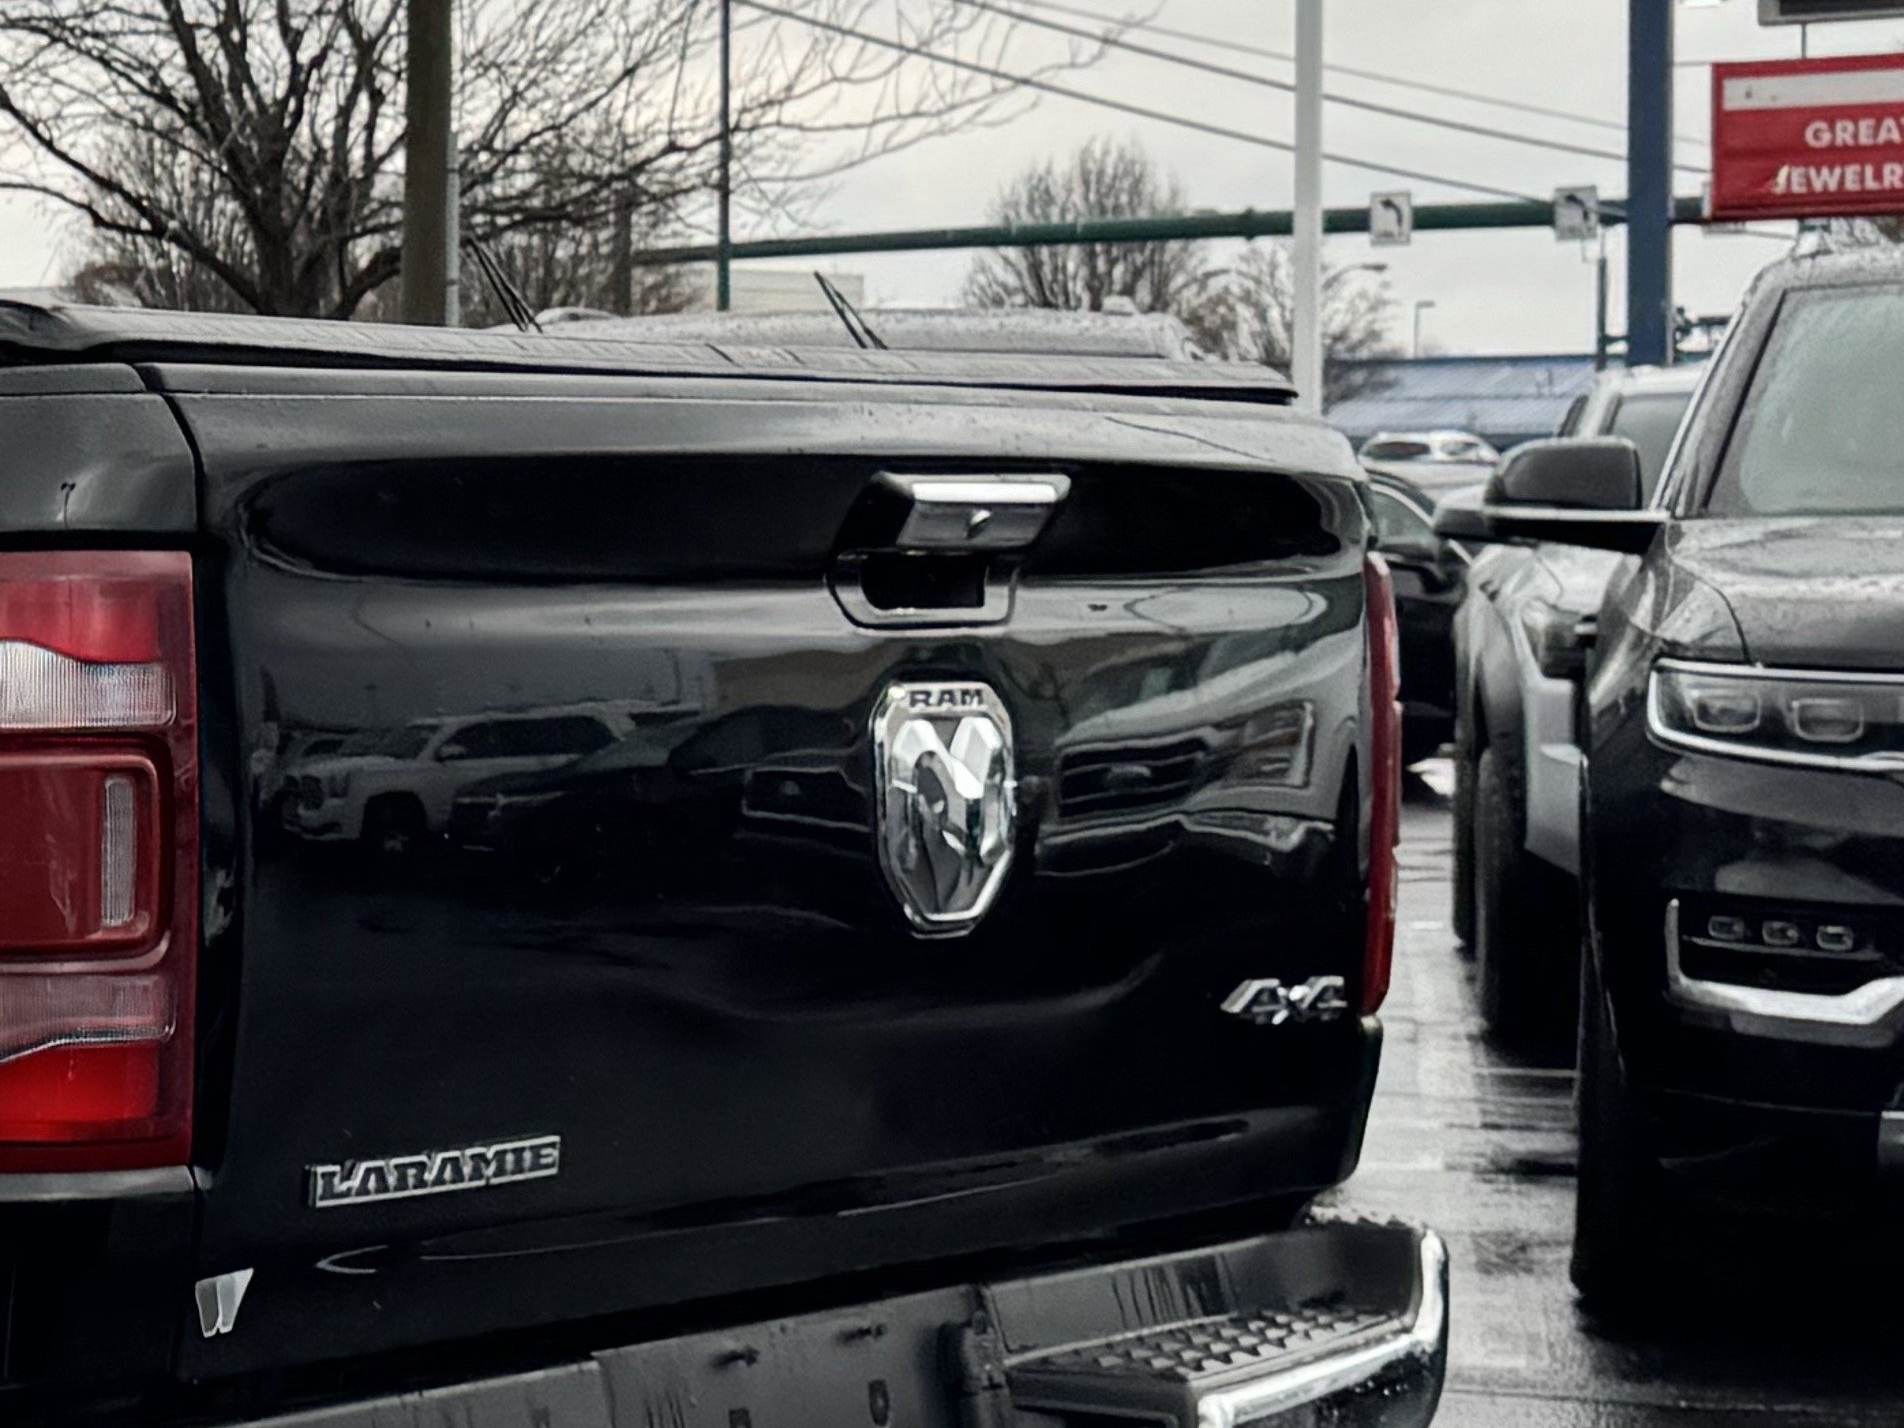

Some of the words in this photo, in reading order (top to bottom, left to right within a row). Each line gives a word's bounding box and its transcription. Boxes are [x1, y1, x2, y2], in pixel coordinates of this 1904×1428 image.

[1804, 117, 1904, 149] GREA
[909, 688, 984, 708] RAM
[312, 1135, 561, 1208] LARAMIE
